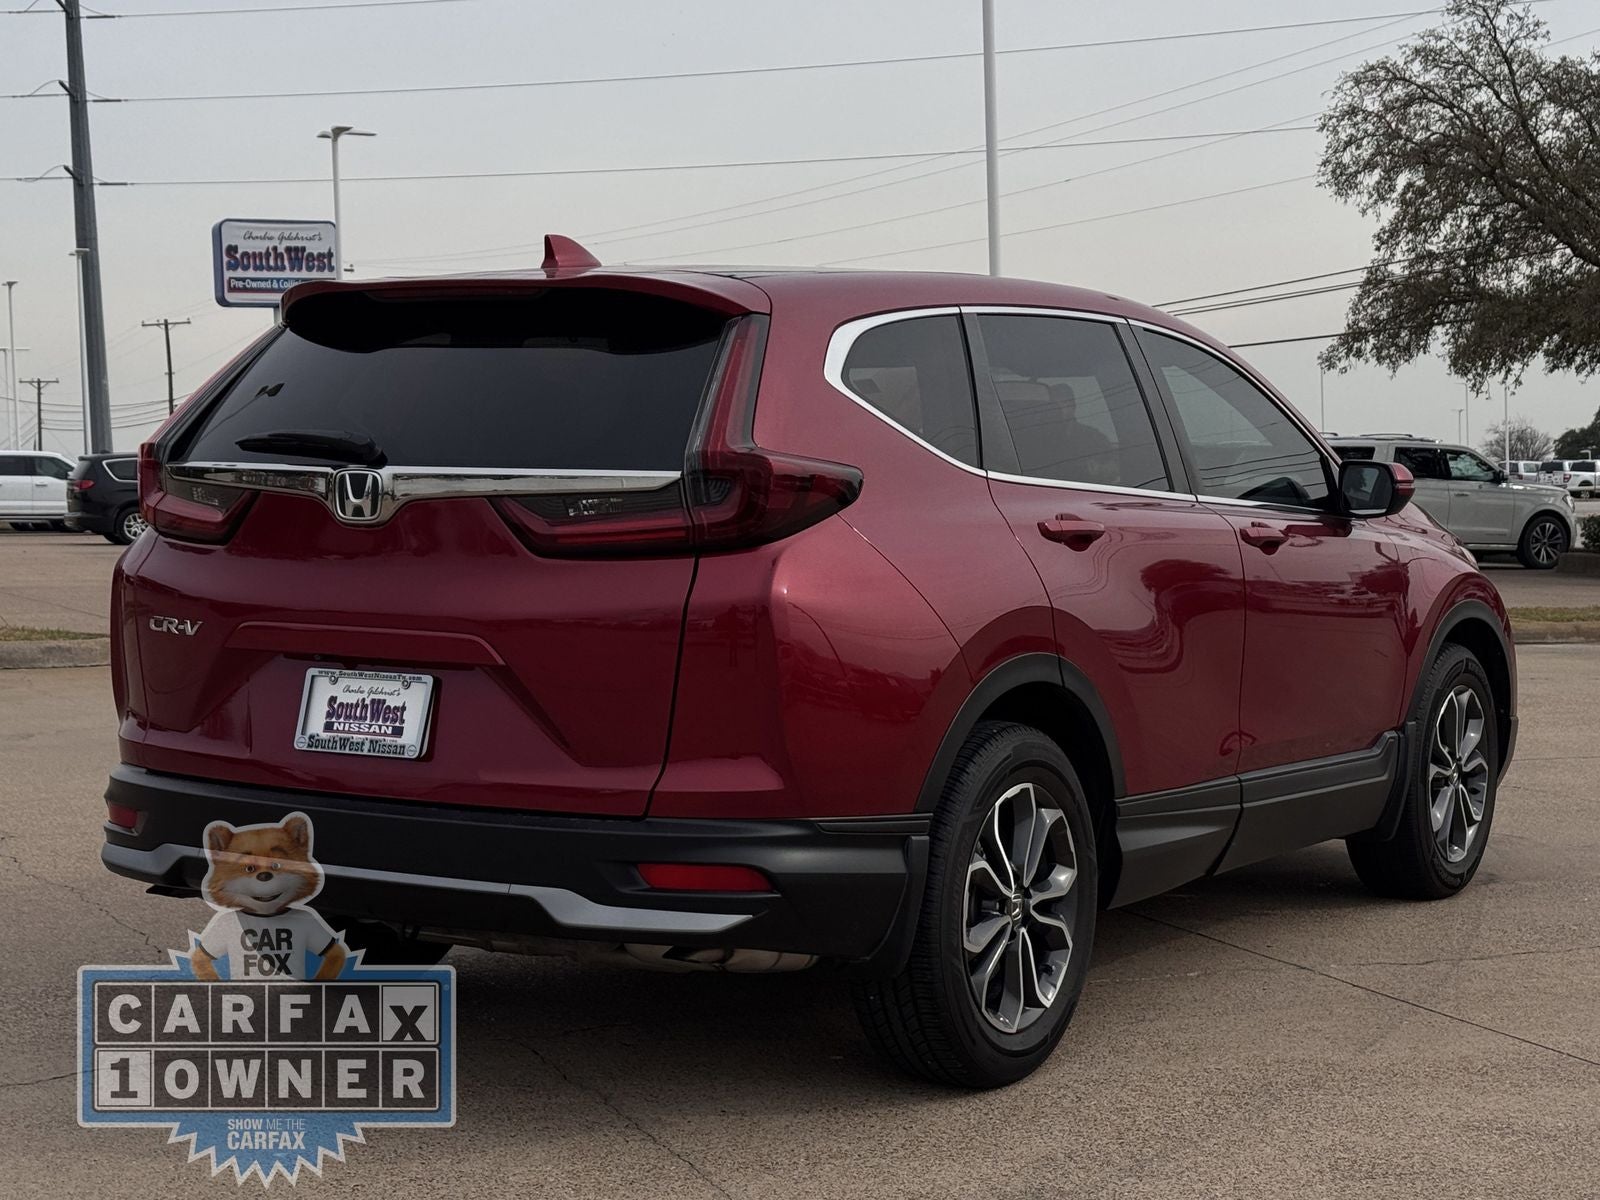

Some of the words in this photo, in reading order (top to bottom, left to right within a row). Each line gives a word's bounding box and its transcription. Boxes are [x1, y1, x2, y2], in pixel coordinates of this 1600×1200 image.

[225, 243, 335, 273] SouthWest
[230, 279, 271, 289] Pre-Owned
[272, 279, 279, 289] &
[149, 615, 203, 636] CR-V
[325, 695, 407, 725] SouthWest
[333, 722, 393, 735] NISSAN
[307, 732, 366, 753] SouthWest
[367, 738, 406, 756] Nissan
